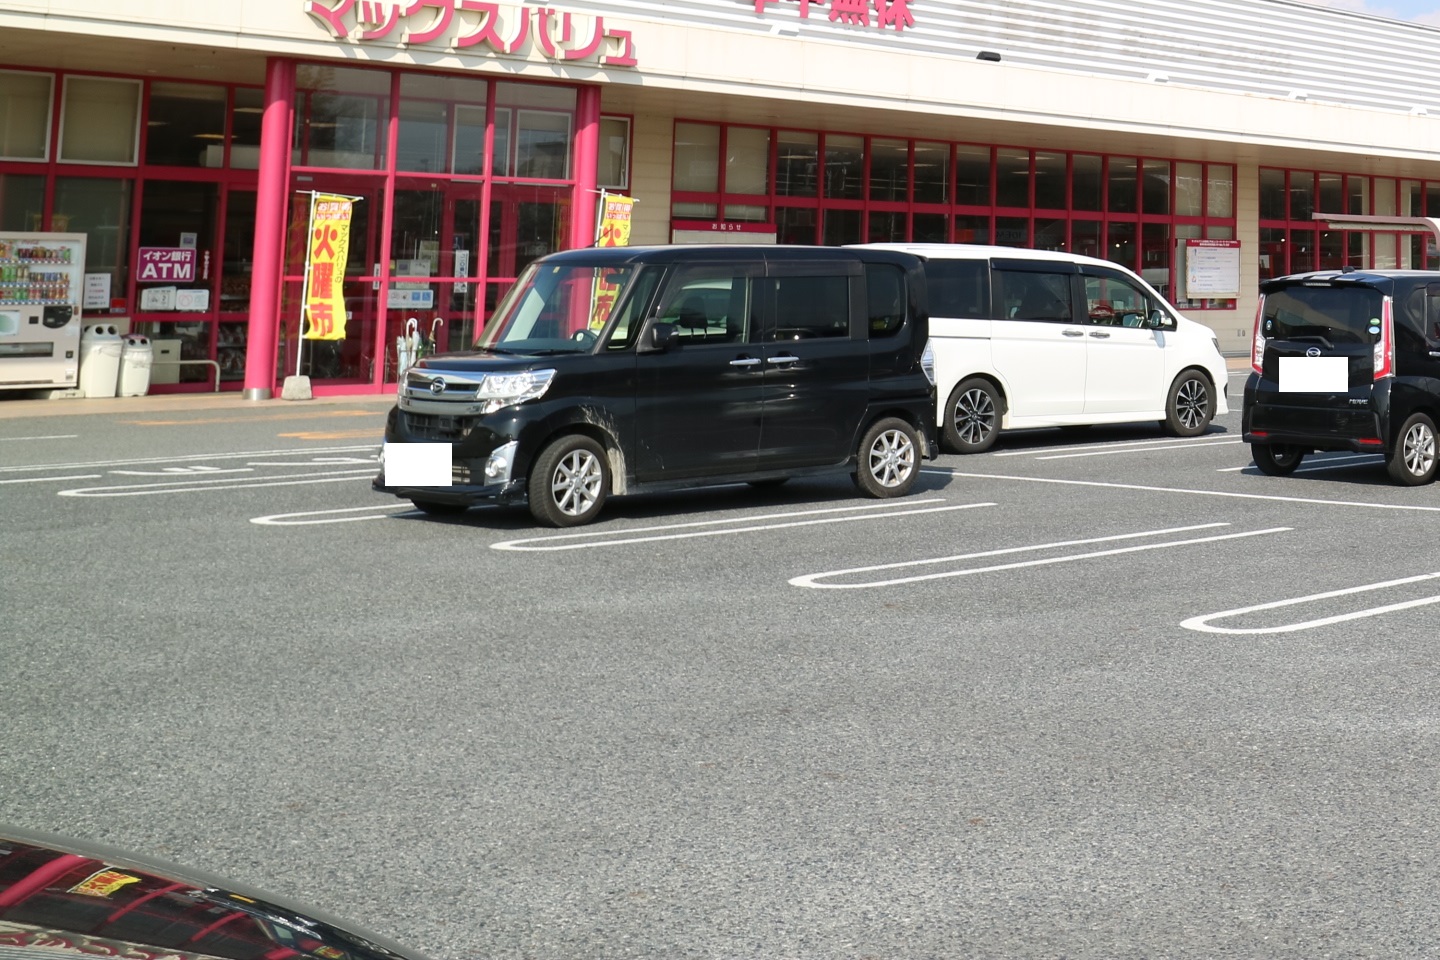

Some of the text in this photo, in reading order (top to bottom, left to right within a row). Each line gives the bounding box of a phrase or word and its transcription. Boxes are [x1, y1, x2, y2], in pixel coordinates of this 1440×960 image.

[143, 250, 192, 262] イオン銀行
[142, 263, 191, 279] ATM
[310, 224, 338, 336] 火曜市
